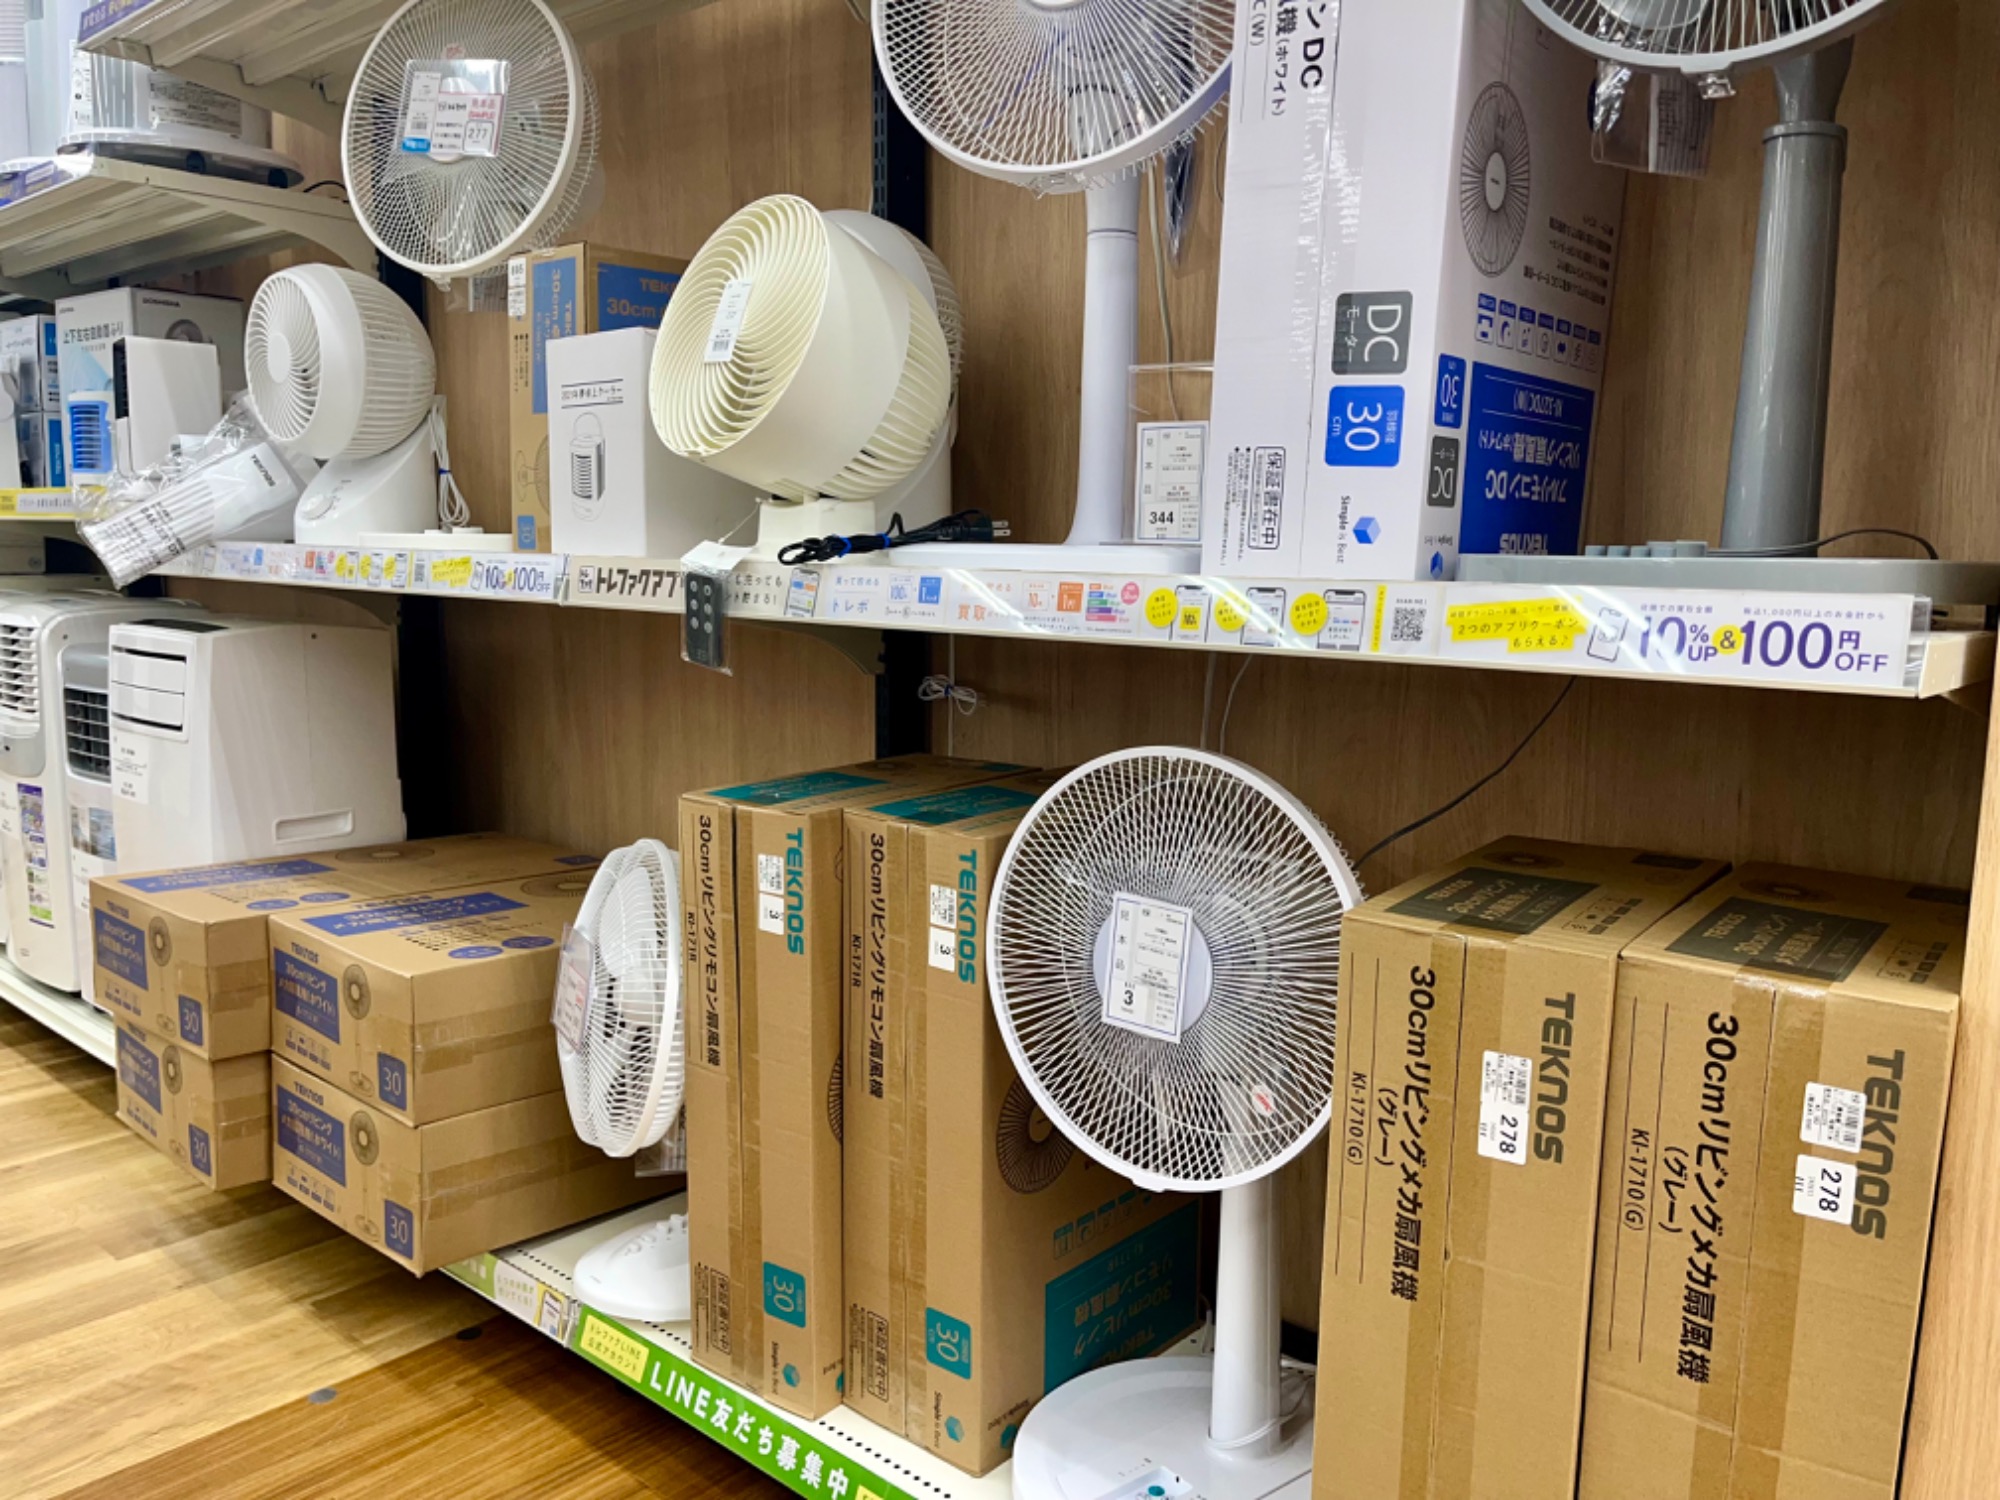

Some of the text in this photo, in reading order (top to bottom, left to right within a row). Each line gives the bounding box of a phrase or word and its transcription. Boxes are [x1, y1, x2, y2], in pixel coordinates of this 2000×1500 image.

[1272, 0, 1298, 116] 機(ホワイト)
[1299, 36, 1325, 90] DC
[468, 127, 489, 140] 277
[1345, 304, 1361, 363] モーター
[1363, 303, 1402, 363] DC
[1440, 373, 1460, 409] 30
[1331, 416, 1343, 437] cm
[1344, 401, 1383, 452] 30
[1261, 451, 1283, 544] 保証書在中
[1431, 466, 1455, 499] DC
[1148, 510, 1174, 525] 344
[1337, 495, 1351, 530] Simple
[1687, 645, 1719, 663] UP
[1719, 631, 1737, 650] &
[1740, 619, 1833, 670] 100
[1834, 652, 1889, 674] OFF
[786, 826, 804, 956] TEKNOS
[957, 848, 978, 985] TEKNOS
[850, 934, 862, 988] KI-171R
[868, 832, 886, 1100] 30cmリビングリモコン扇風機
[940, 943, 951, 956] 3
[183, 1007, 199, 1035] 30
[1123, 989, 1135, 1007] 3
[382, 1067, 401, 1097] 30
[1533, 991, 1576, 1165] TEKNOS
[1346, 1070, 1366, 1167] KI-1710(G)
[1372, 1086, 1400, 1168] (グレー)
[1390, 964, 1436, 1303] 30cmリビングメカ扇風機
[1498, 1113, 1519, 1155] 278
[193, 1136, 208, 1164] 30
[1850, 1049, 1906, 1241] TEKNOS
[1622, 1126, 1649, 1233] KI-1710(G)
[1657, 1145, 1690, 1236] (グレー)
[1675, 1011, 1740, 1385] 30cmリビングメカ扇風機
[1818, 1167, 1843, 1214] 278
[389, 1214, 409, 1245] 30
[773, 1275, 795, 1313] 30
[935, 1322, 960, 1362] 30
[649, 1360, 850, 1500] LINE友だち募集中
